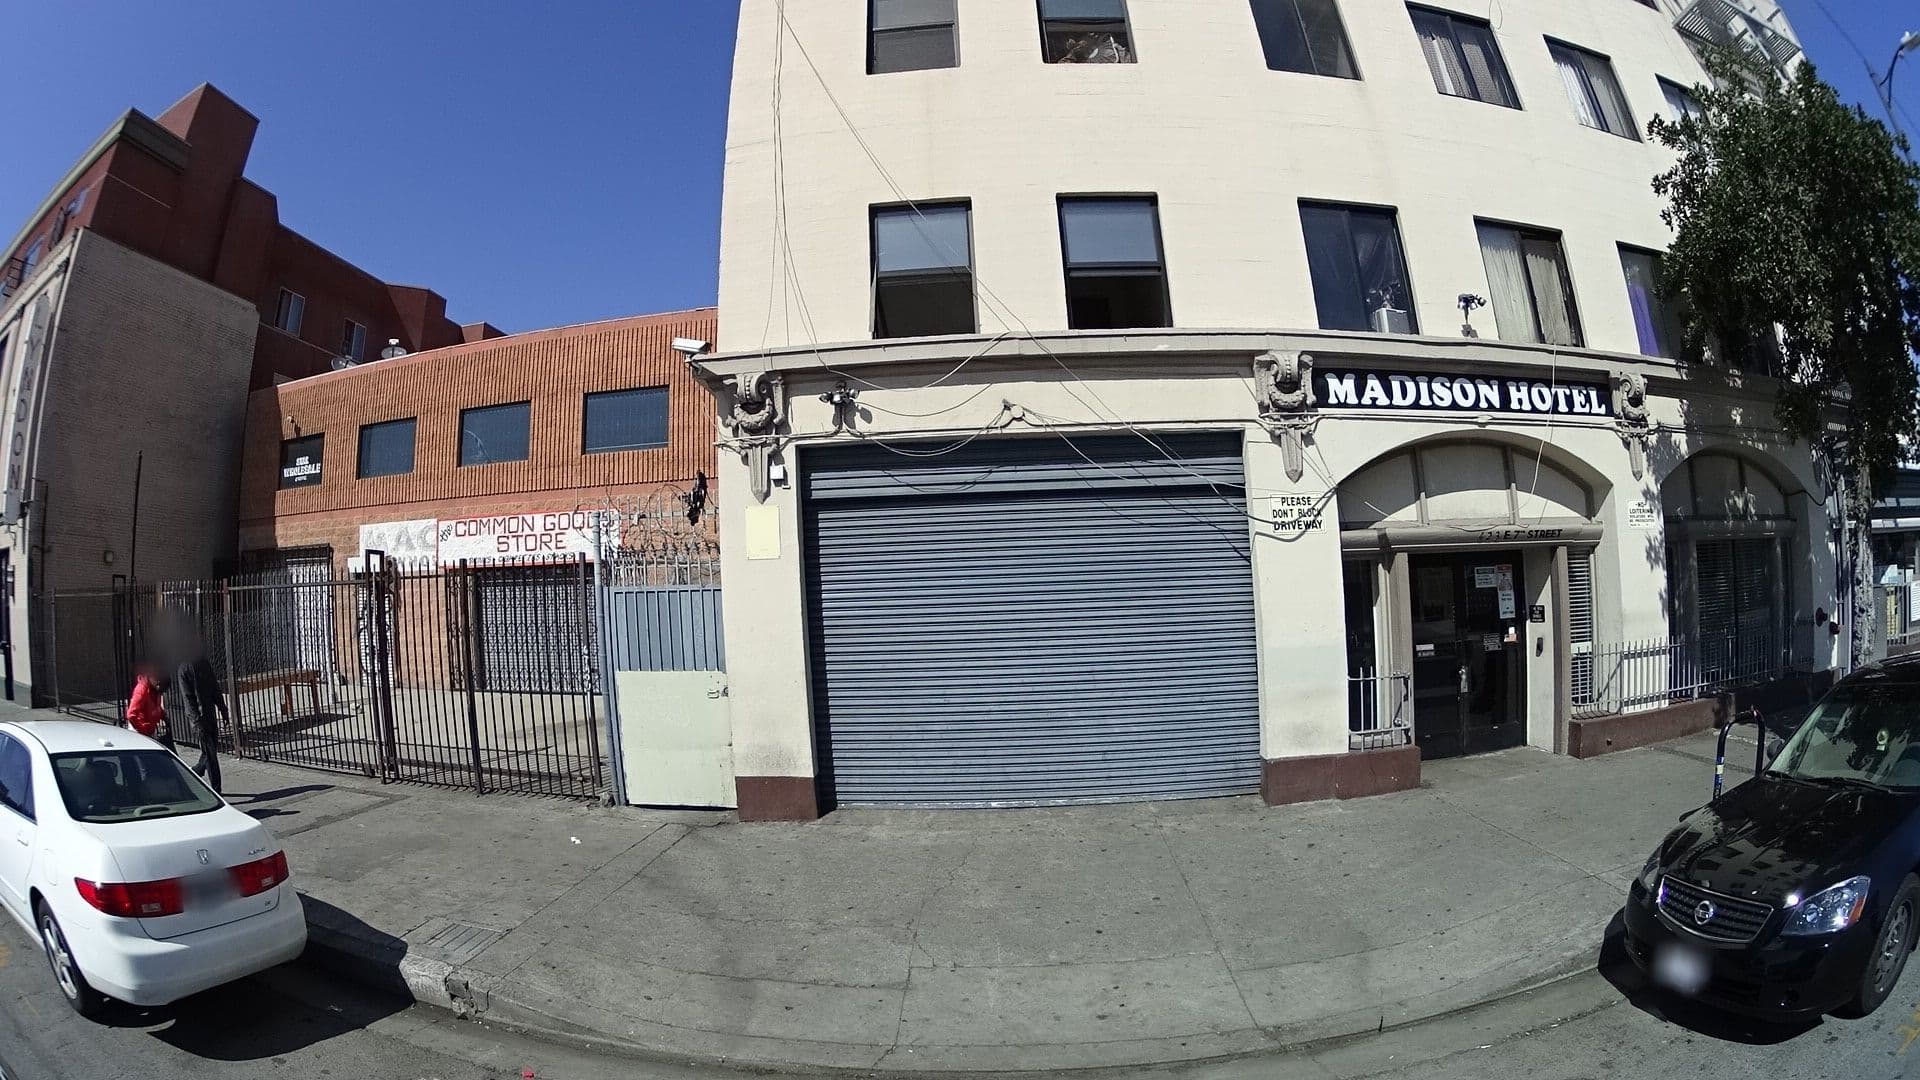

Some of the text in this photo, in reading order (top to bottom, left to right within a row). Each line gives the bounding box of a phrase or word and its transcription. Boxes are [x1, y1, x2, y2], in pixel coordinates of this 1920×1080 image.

[1325, 373, 1607, 415] MADISON HOTEL
[1281, 496, 1312, 506] PLEASE
[1297, 507, 1322, 518] BLOCK
[455, 517, 535, 537] COMMON
[1273, 519, 1323, 531] DRIVEWAY
[1503, 530, 1511, 540] E
[1527, 529, 1563, 539] STREET
[496, 532, 567, 552] STORE
